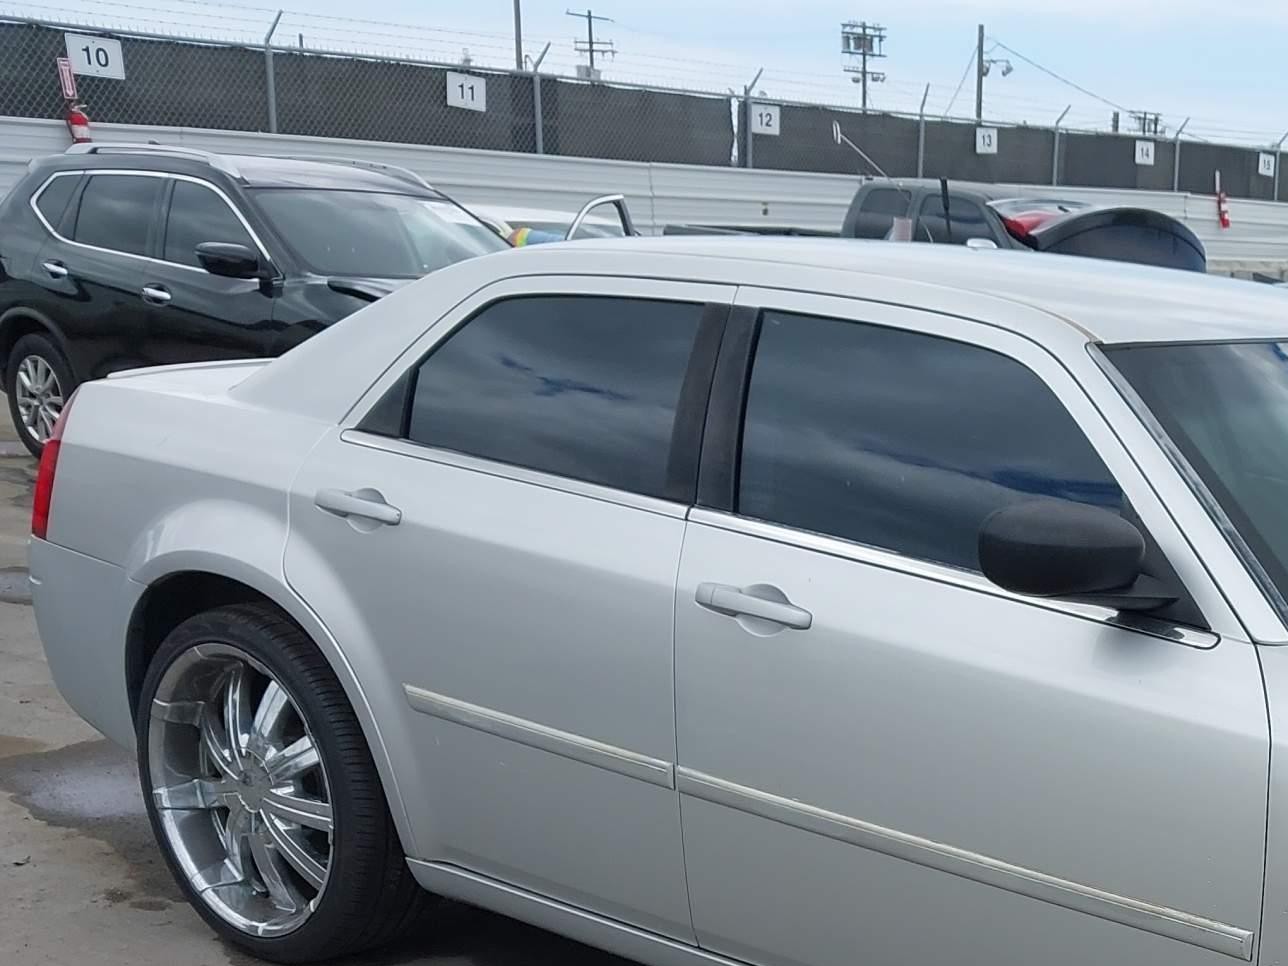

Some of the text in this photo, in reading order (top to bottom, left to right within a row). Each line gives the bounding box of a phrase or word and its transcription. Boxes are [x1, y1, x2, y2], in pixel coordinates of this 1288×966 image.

[82, 45, 109, 68] 10
[458, 83, 475, 101] 11
[759, 112, 772, 128] 12
[982, 133, 992, 148] 13
